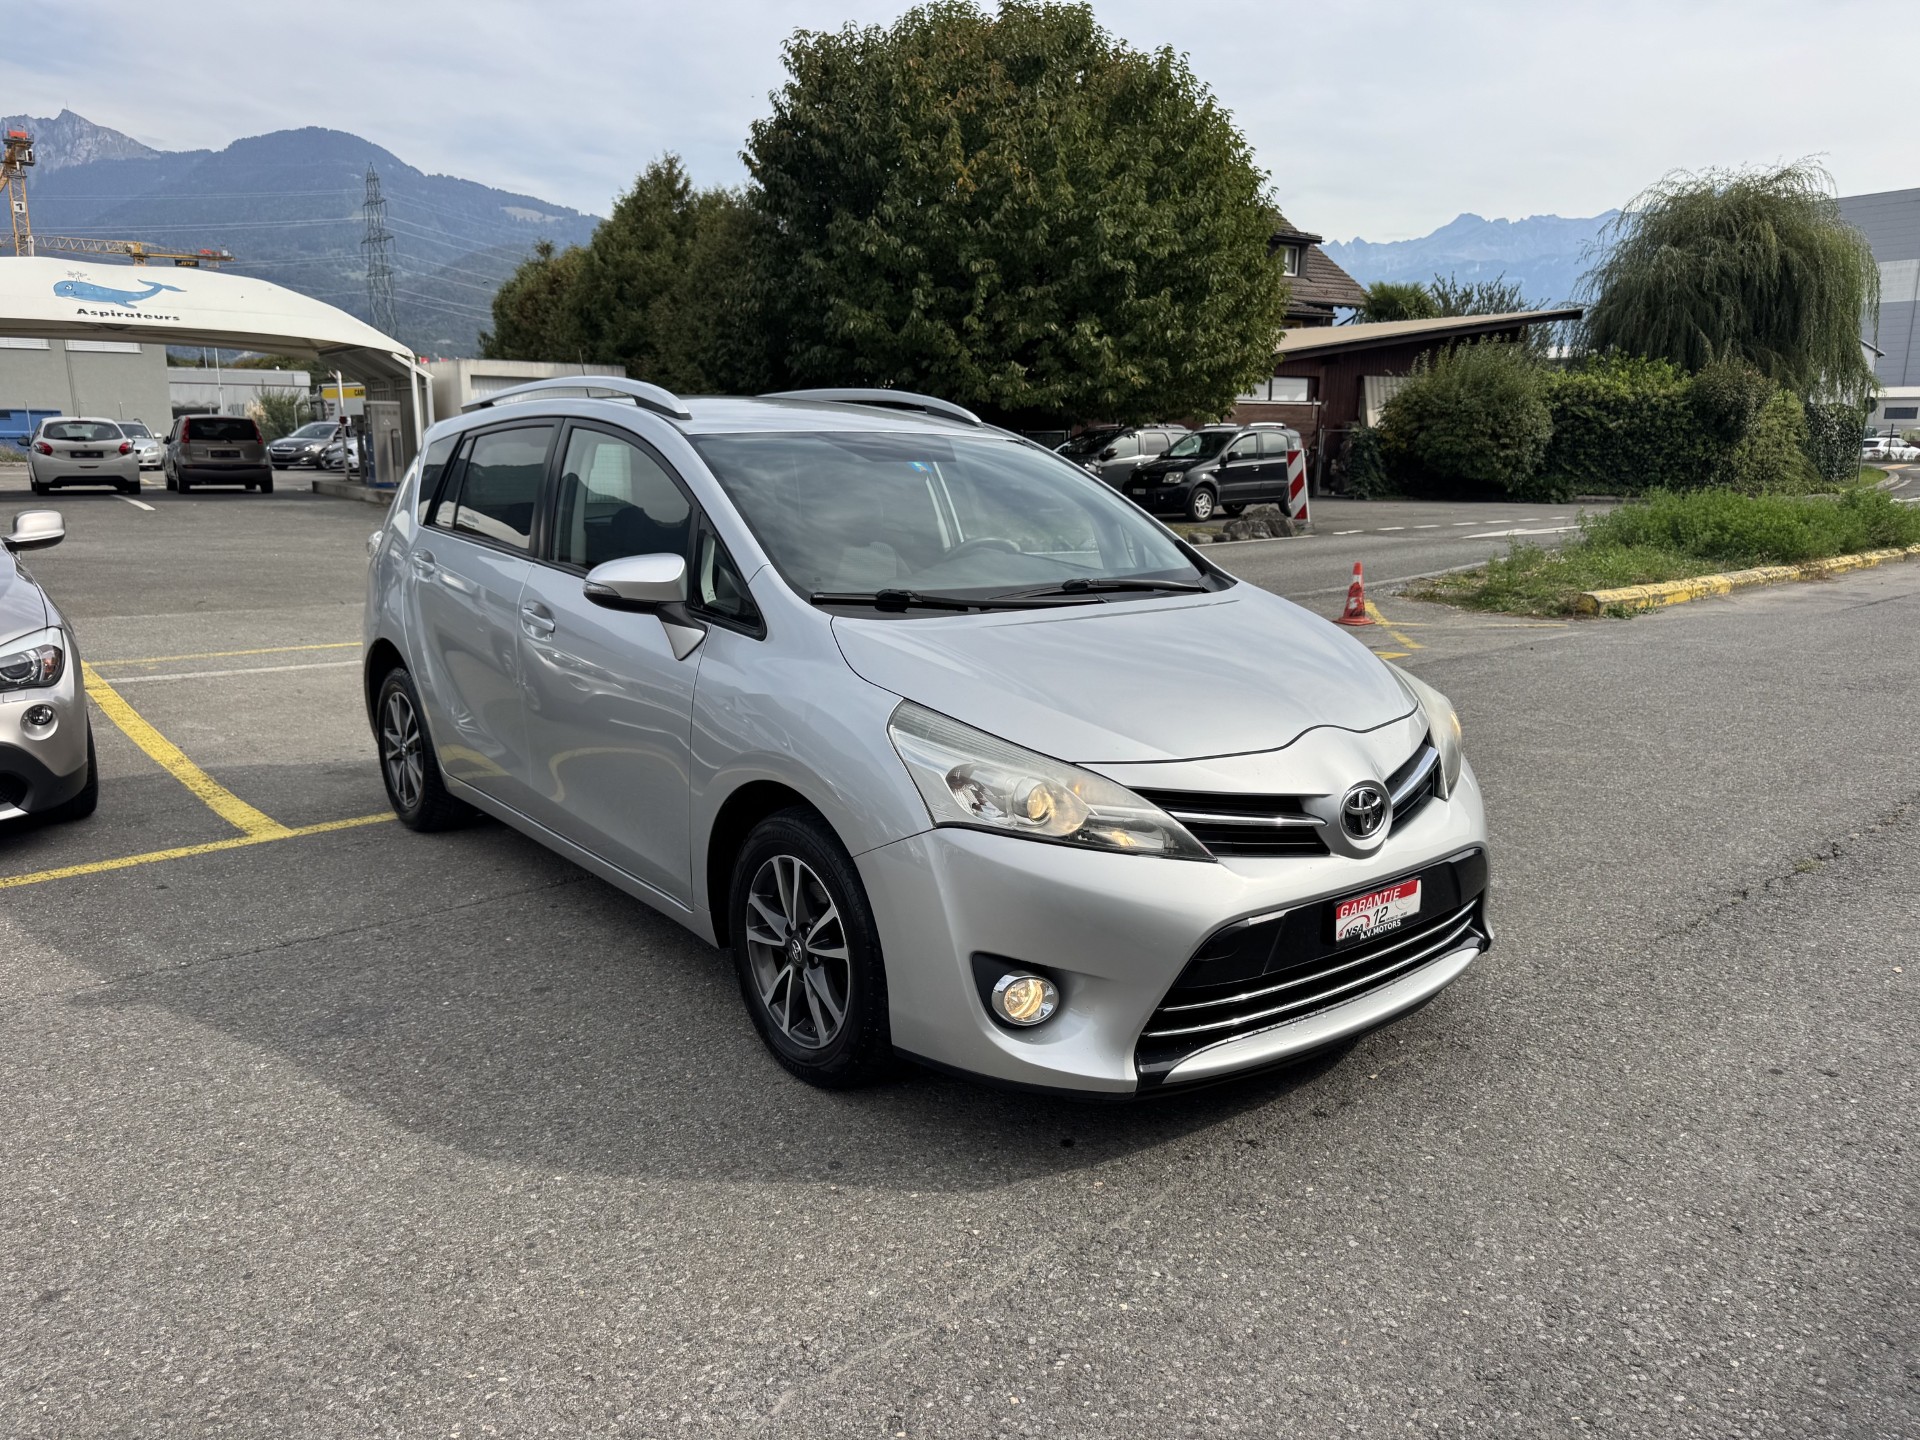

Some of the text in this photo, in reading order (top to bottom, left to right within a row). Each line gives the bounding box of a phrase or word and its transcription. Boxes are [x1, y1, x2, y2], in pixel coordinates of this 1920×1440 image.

[76, 308, 181, 321] Aspirateurs
[1340, 887, 1401, 918] GARANTIE
[1373, 905, 1389, 926] 12
[1344, 923, 1364, 938] NSA
